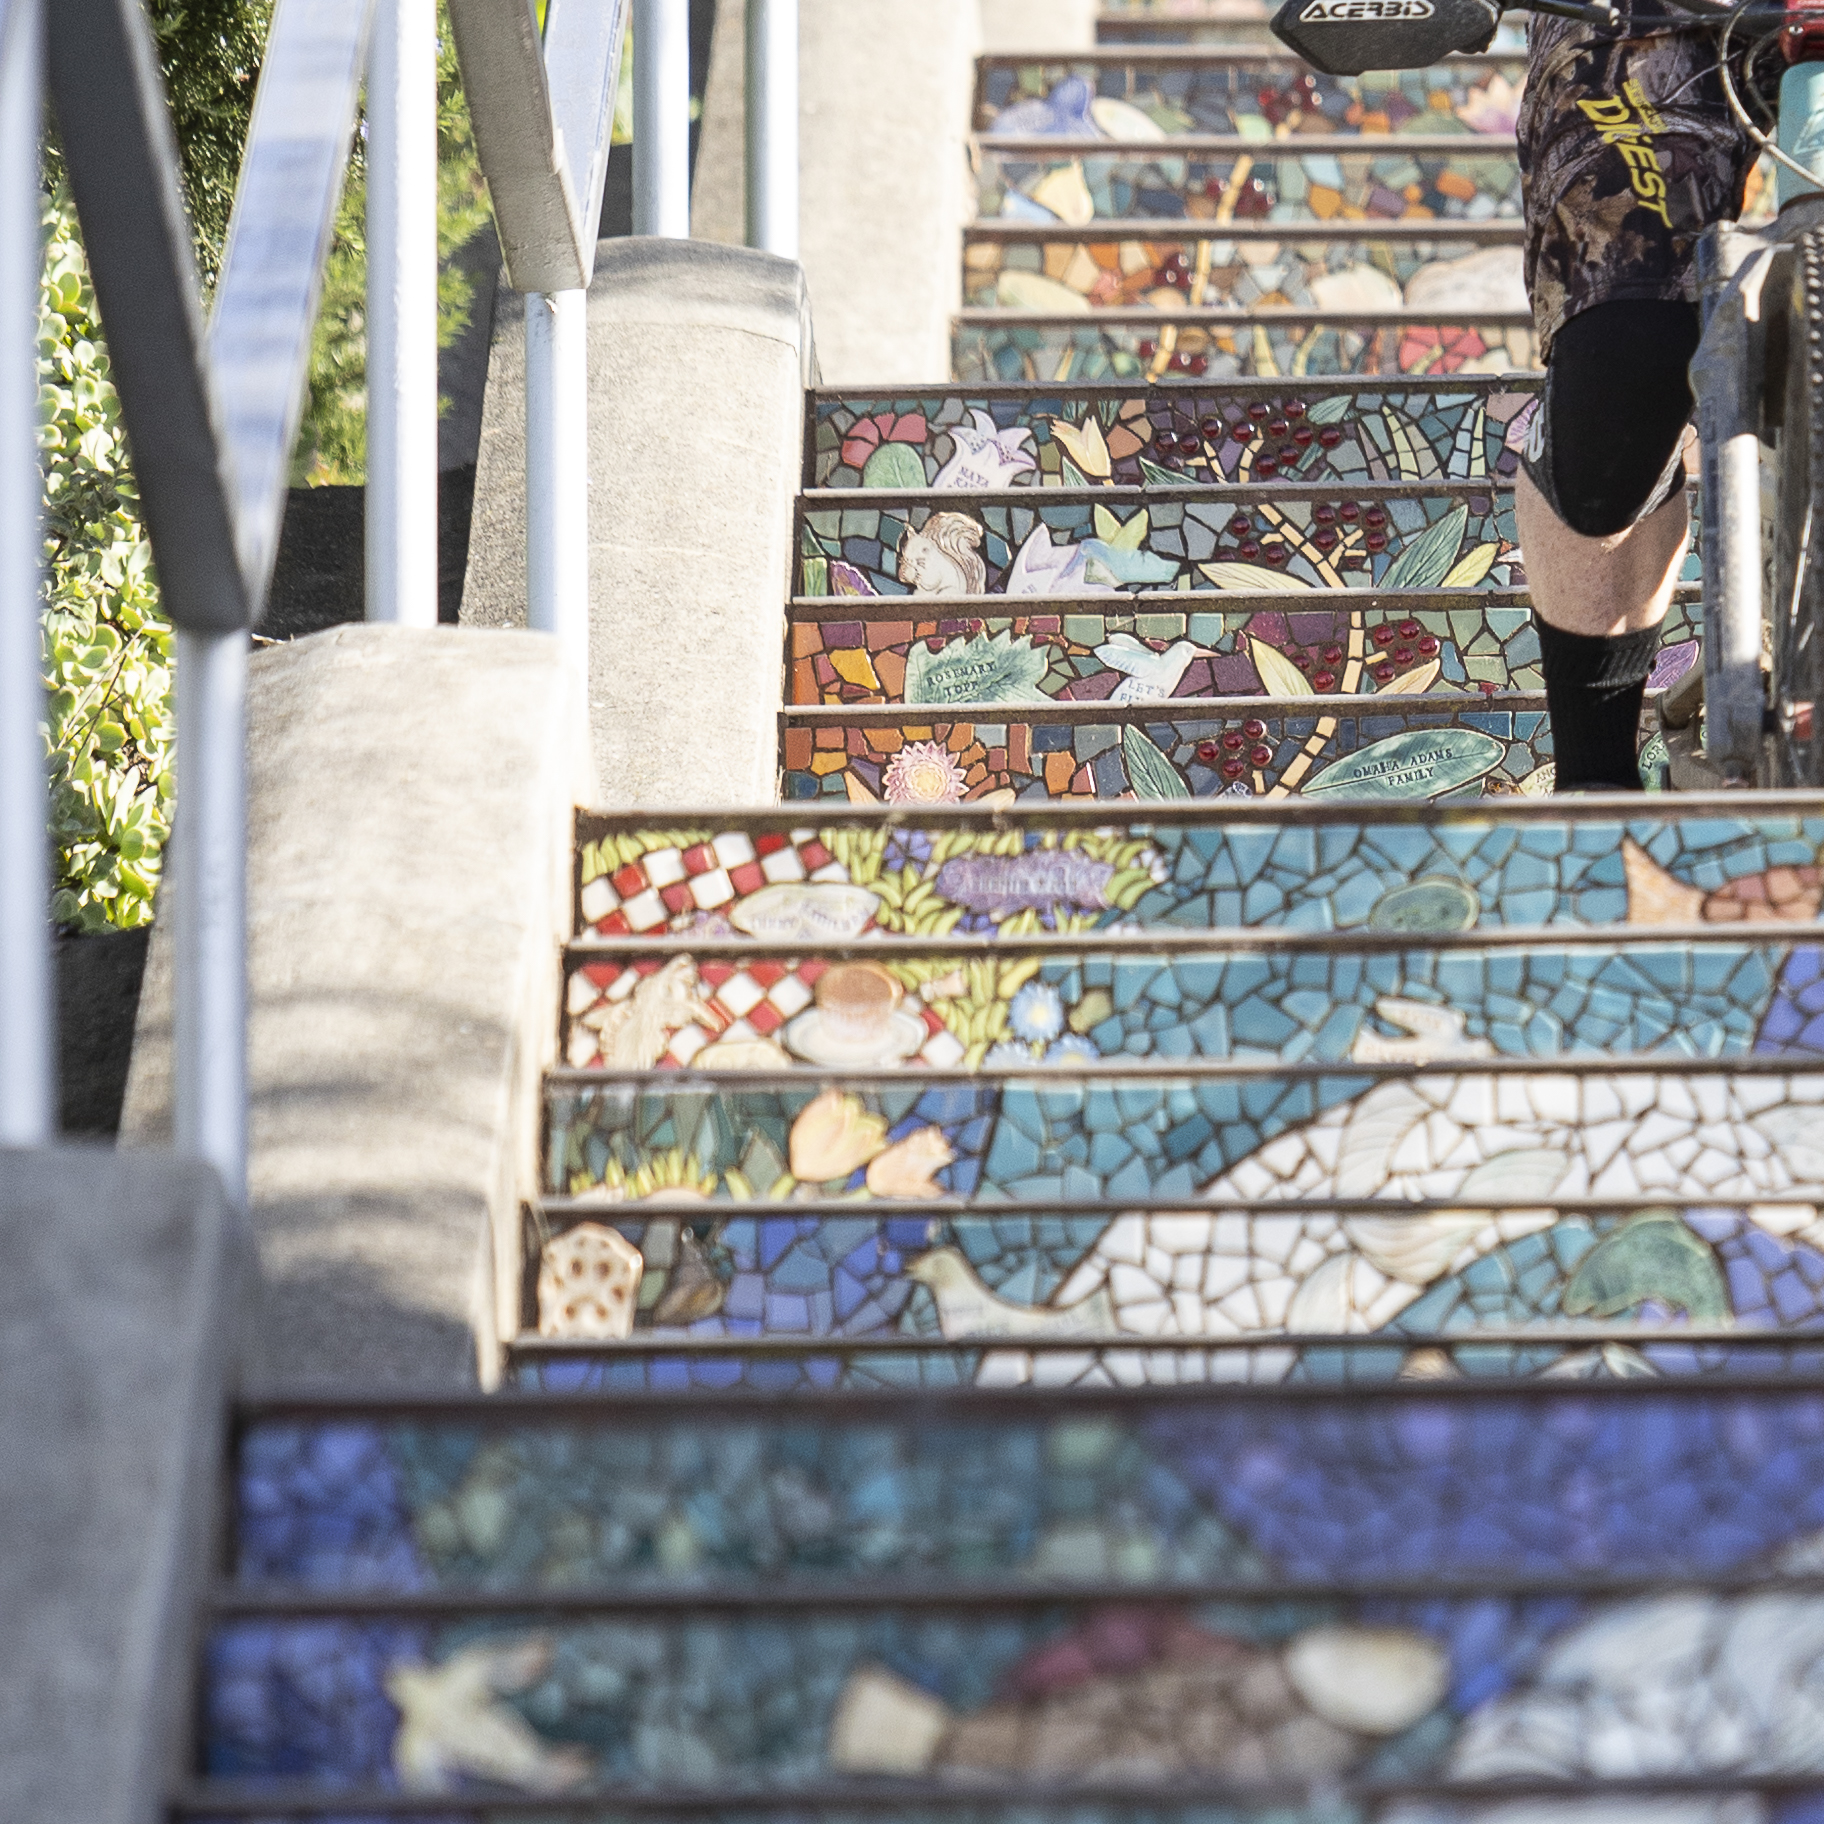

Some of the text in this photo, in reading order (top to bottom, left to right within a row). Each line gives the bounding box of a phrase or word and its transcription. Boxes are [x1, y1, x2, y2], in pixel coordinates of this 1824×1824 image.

[926, 661, 997, 688] ROSEMARY
[1128, 679, 1166, 699] LET'S
[1353, 748, 1453, 778] OMAHA ADAMS
[1387, 767, 1434, 786] FAMILY
